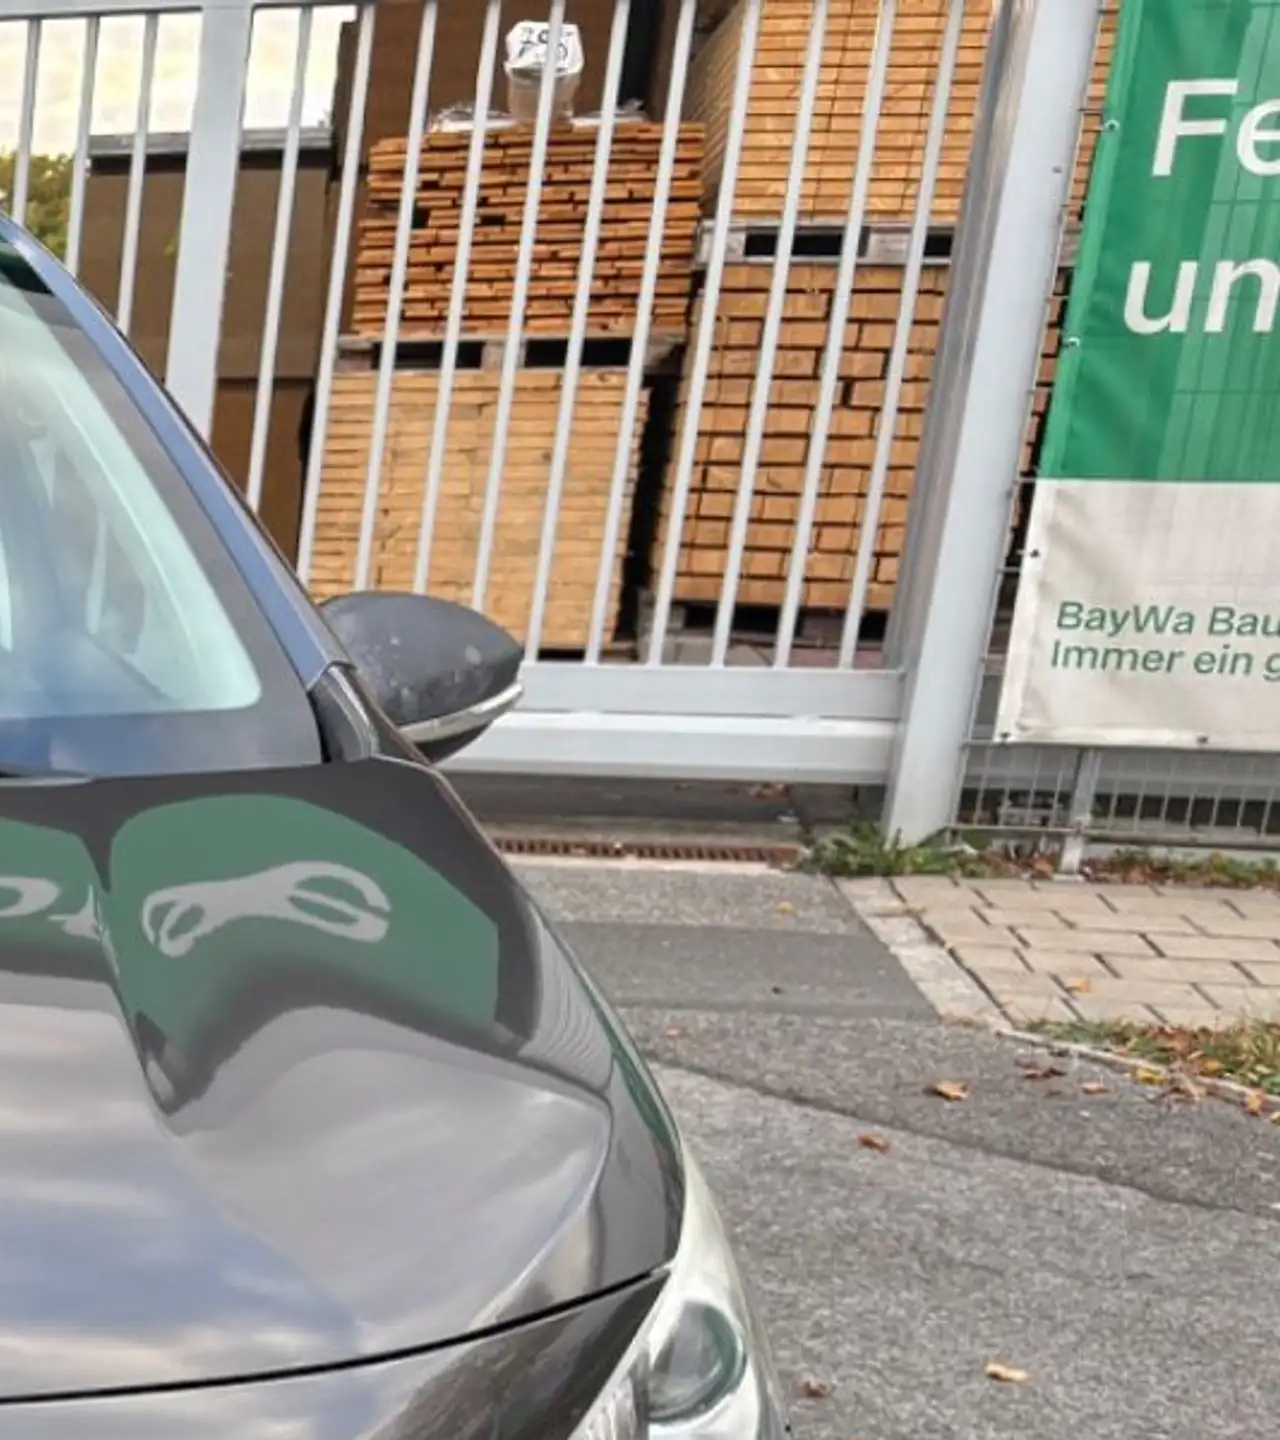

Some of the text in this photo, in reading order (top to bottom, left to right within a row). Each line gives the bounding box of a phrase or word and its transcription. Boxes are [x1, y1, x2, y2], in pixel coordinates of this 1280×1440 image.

[1124, 257, 1280, 334] un
[1055, 601, 1280, 638] BayWa Bau
[1050, 639, 1184, 673] Immer
[1193, 644, 1254, 676] ein
